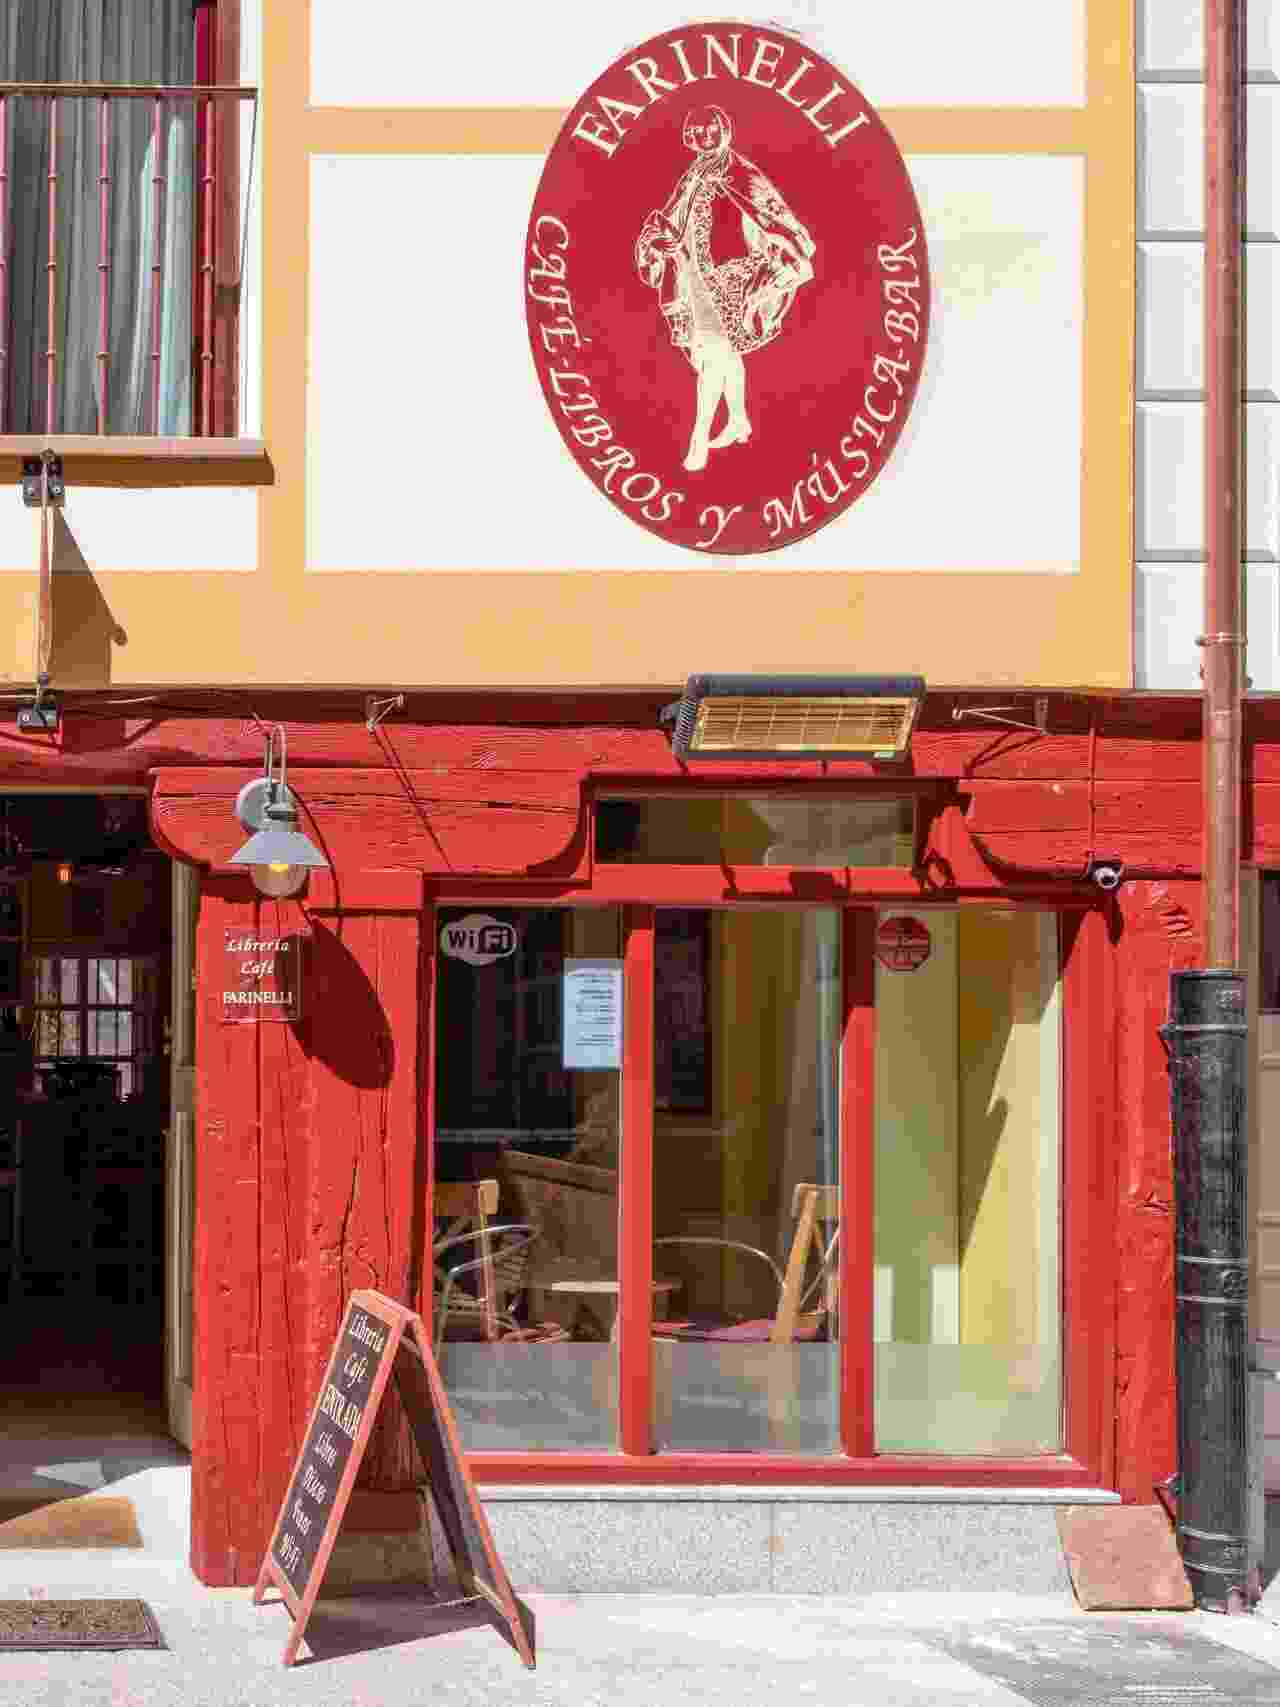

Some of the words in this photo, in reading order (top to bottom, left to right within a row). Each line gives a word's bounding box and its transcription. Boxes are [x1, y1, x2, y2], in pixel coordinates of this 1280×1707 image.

[571, 33, 871, 159] FARINELLI
[696, 504, 743, 547] Y
[223, 991, 294, 1005] FARINELLI
